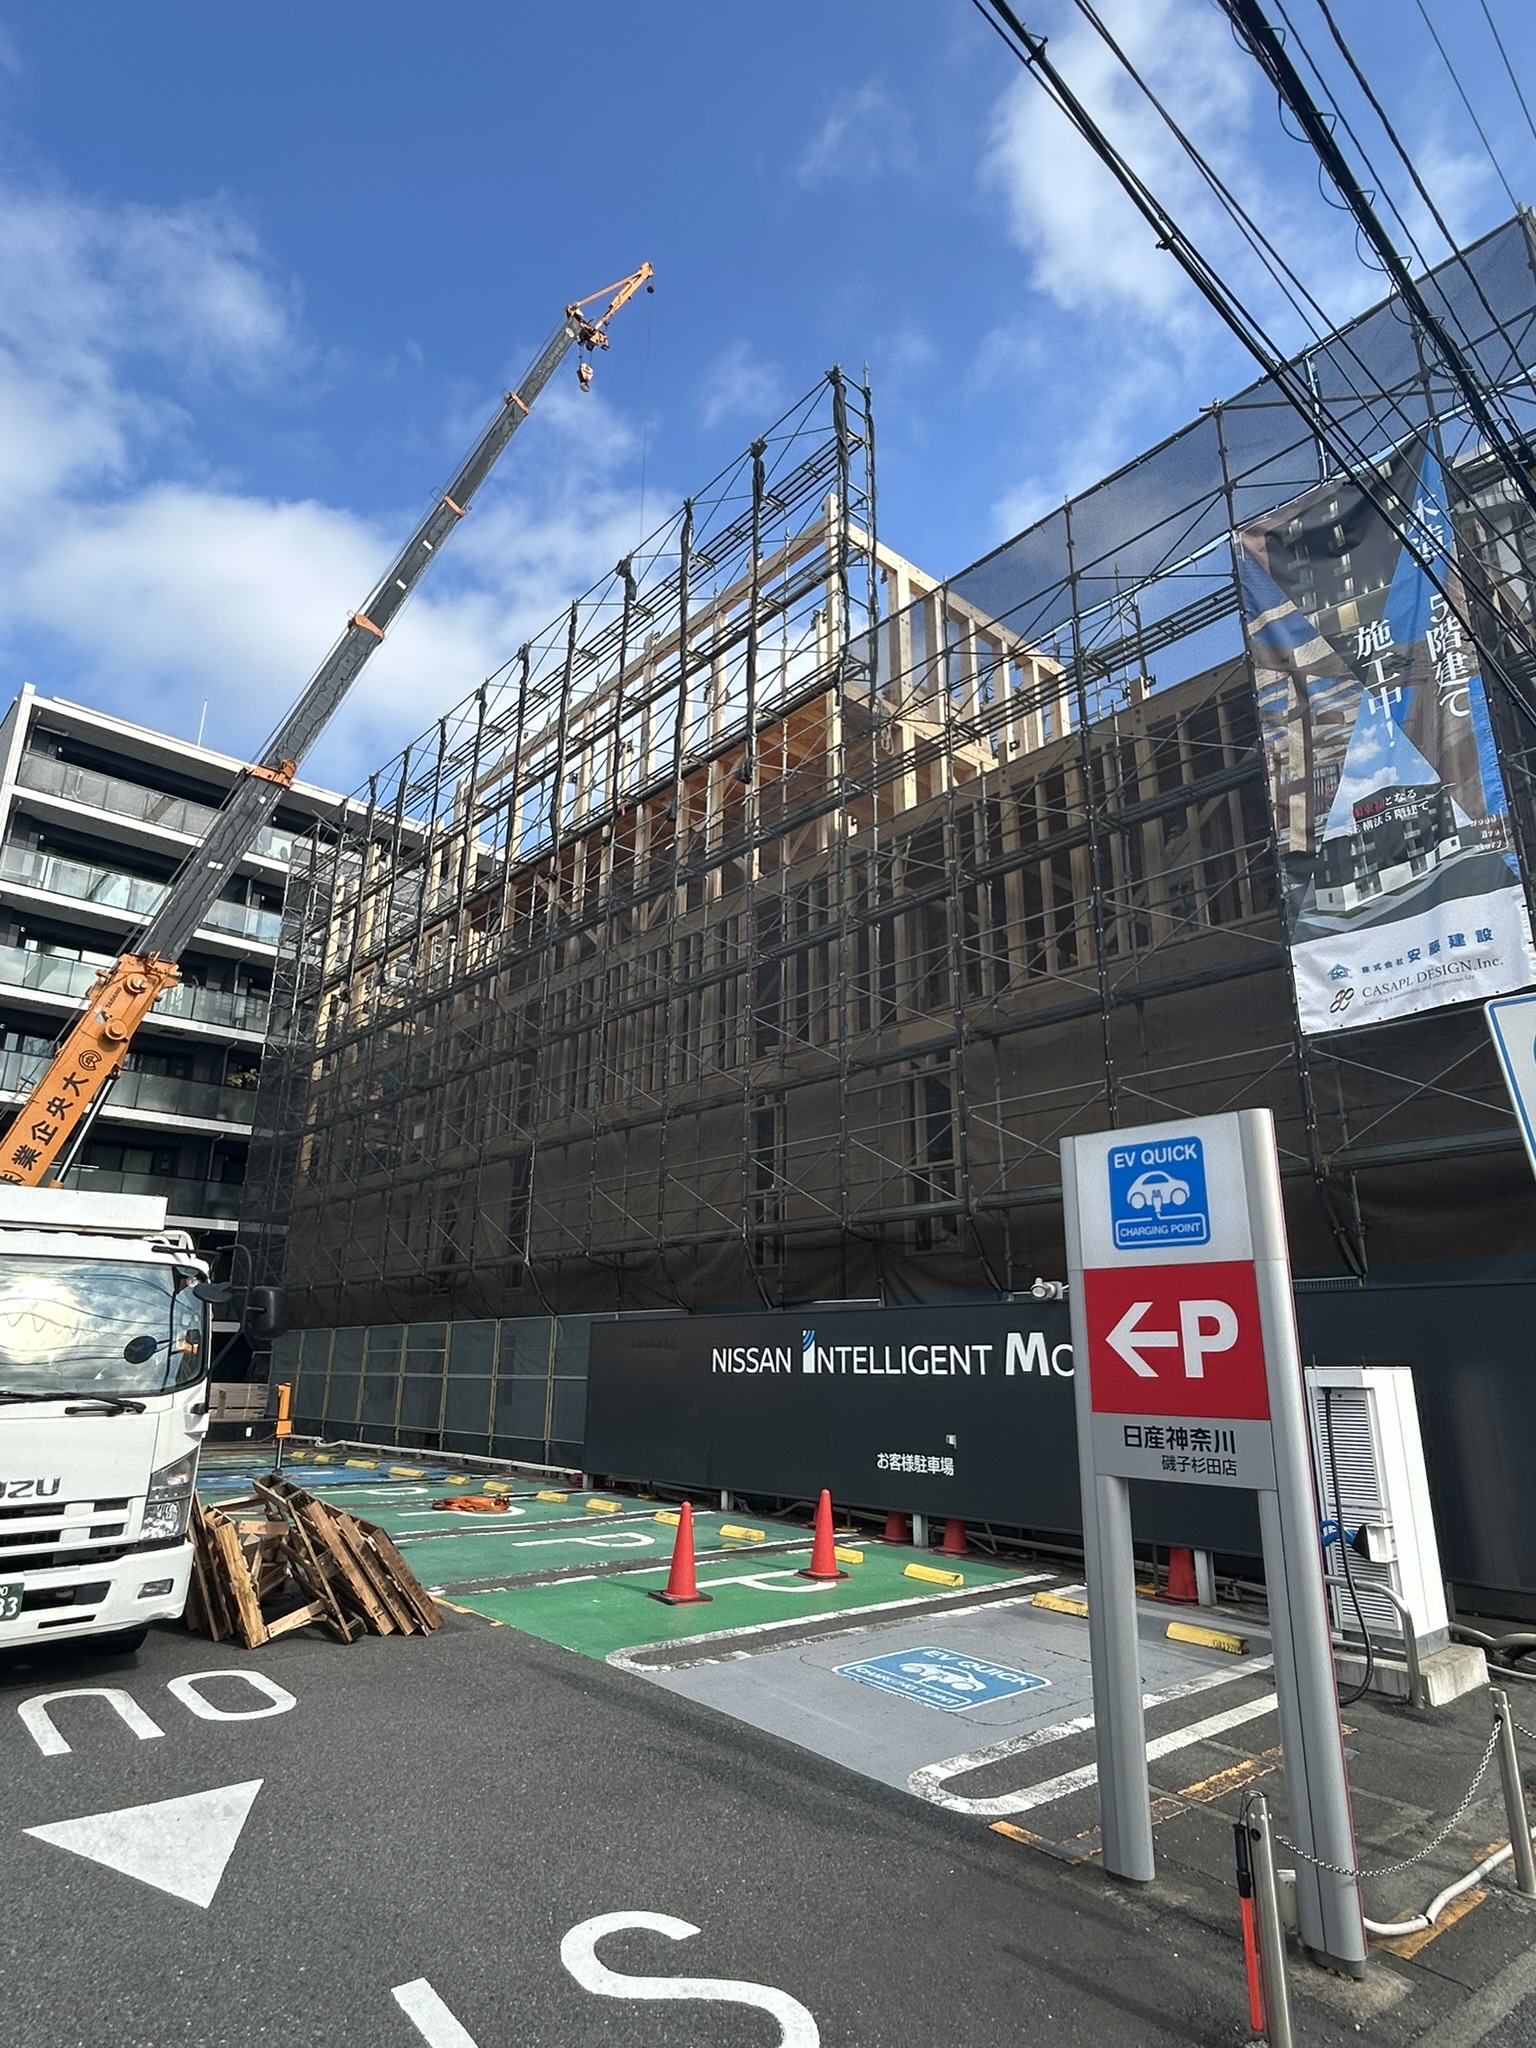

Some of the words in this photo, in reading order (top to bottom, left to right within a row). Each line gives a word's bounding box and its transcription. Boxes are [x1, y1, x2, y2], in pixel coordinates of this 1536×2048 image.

[1362, 976, 1414, 998] CASAPL
[1113, 1152, 1136, 1169] EV
[1140, 1143, 1198, 1166] QUICK
[1119, 1223, 1168, 1238] CHARGING
[1170, 1221, 1201, 1235] POINT
[1179, 1299, 1239, 1378] P
[712, 1347, 792, 1374] NISSAN
[802, 1329, 993, 1376] INTELLIGENT
[1123, 1424, 1236, 1455] 日産神奈川
[877, 1452, 955, 1476] お客様駐車場
[1161, 1454, 1237, 1477] 磯子杉田店
[0, 1476, 61, 1498] ZU
[923, 1650, 958, 1662] EV
[957, 1660, 1035, 1687] QUICK
